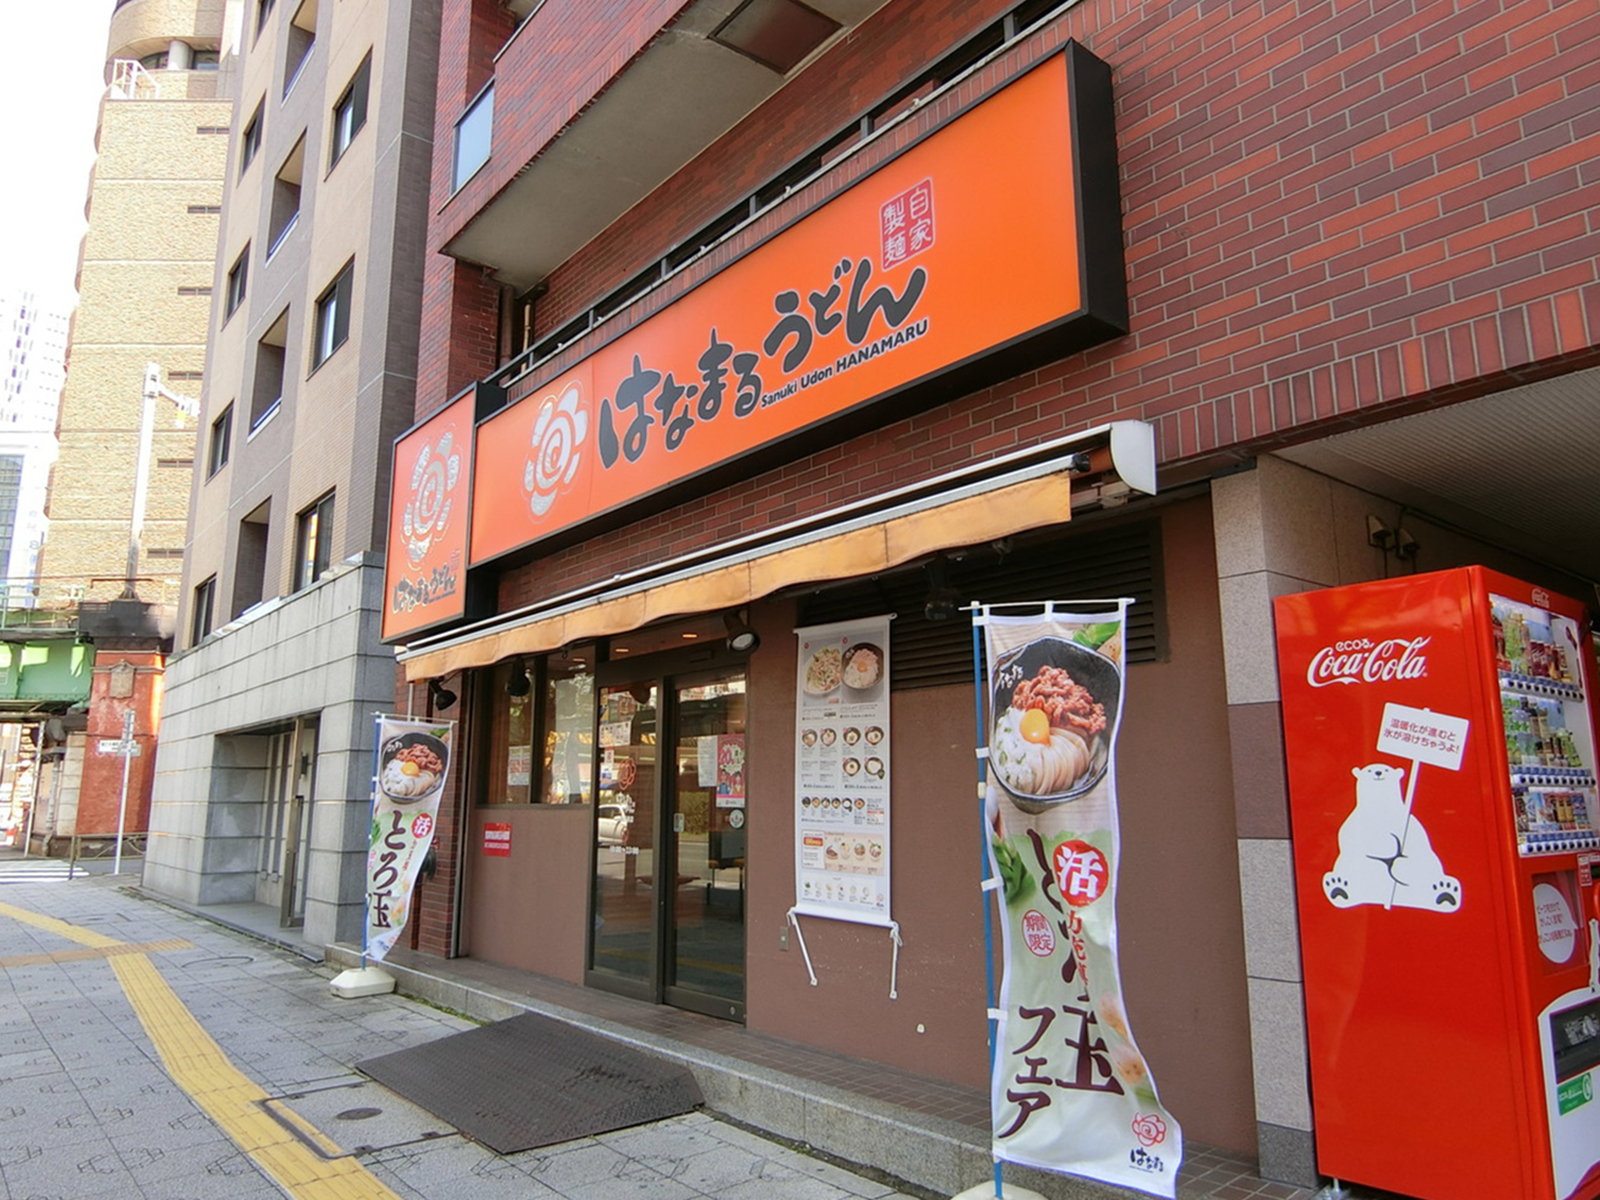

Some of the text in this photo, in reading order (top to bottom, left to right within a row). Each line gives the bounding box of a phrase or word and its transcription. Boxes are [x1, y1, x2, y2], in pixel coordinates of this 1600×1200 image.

[883, 197, 907, 267] 製麺
[909, 186, 932, 251] 自家
[597, 257, 928, 470] はなまるうどん
[761, 319, 928, 409] Sanuki Udon HANAMARU
[1307, 635, 1433, 688] Coca-Cola
[1390, 717, 1457, 742] 温暖化が進むと
[372, 809, 407, 929] とろ玉
[1056, 845, 1104, 899] 活
[1028, 933, 1054, 951] 限定
[997, 1005, 1057, 1139] フェア
[1129, 1146, 1164, 1172] はなまる
